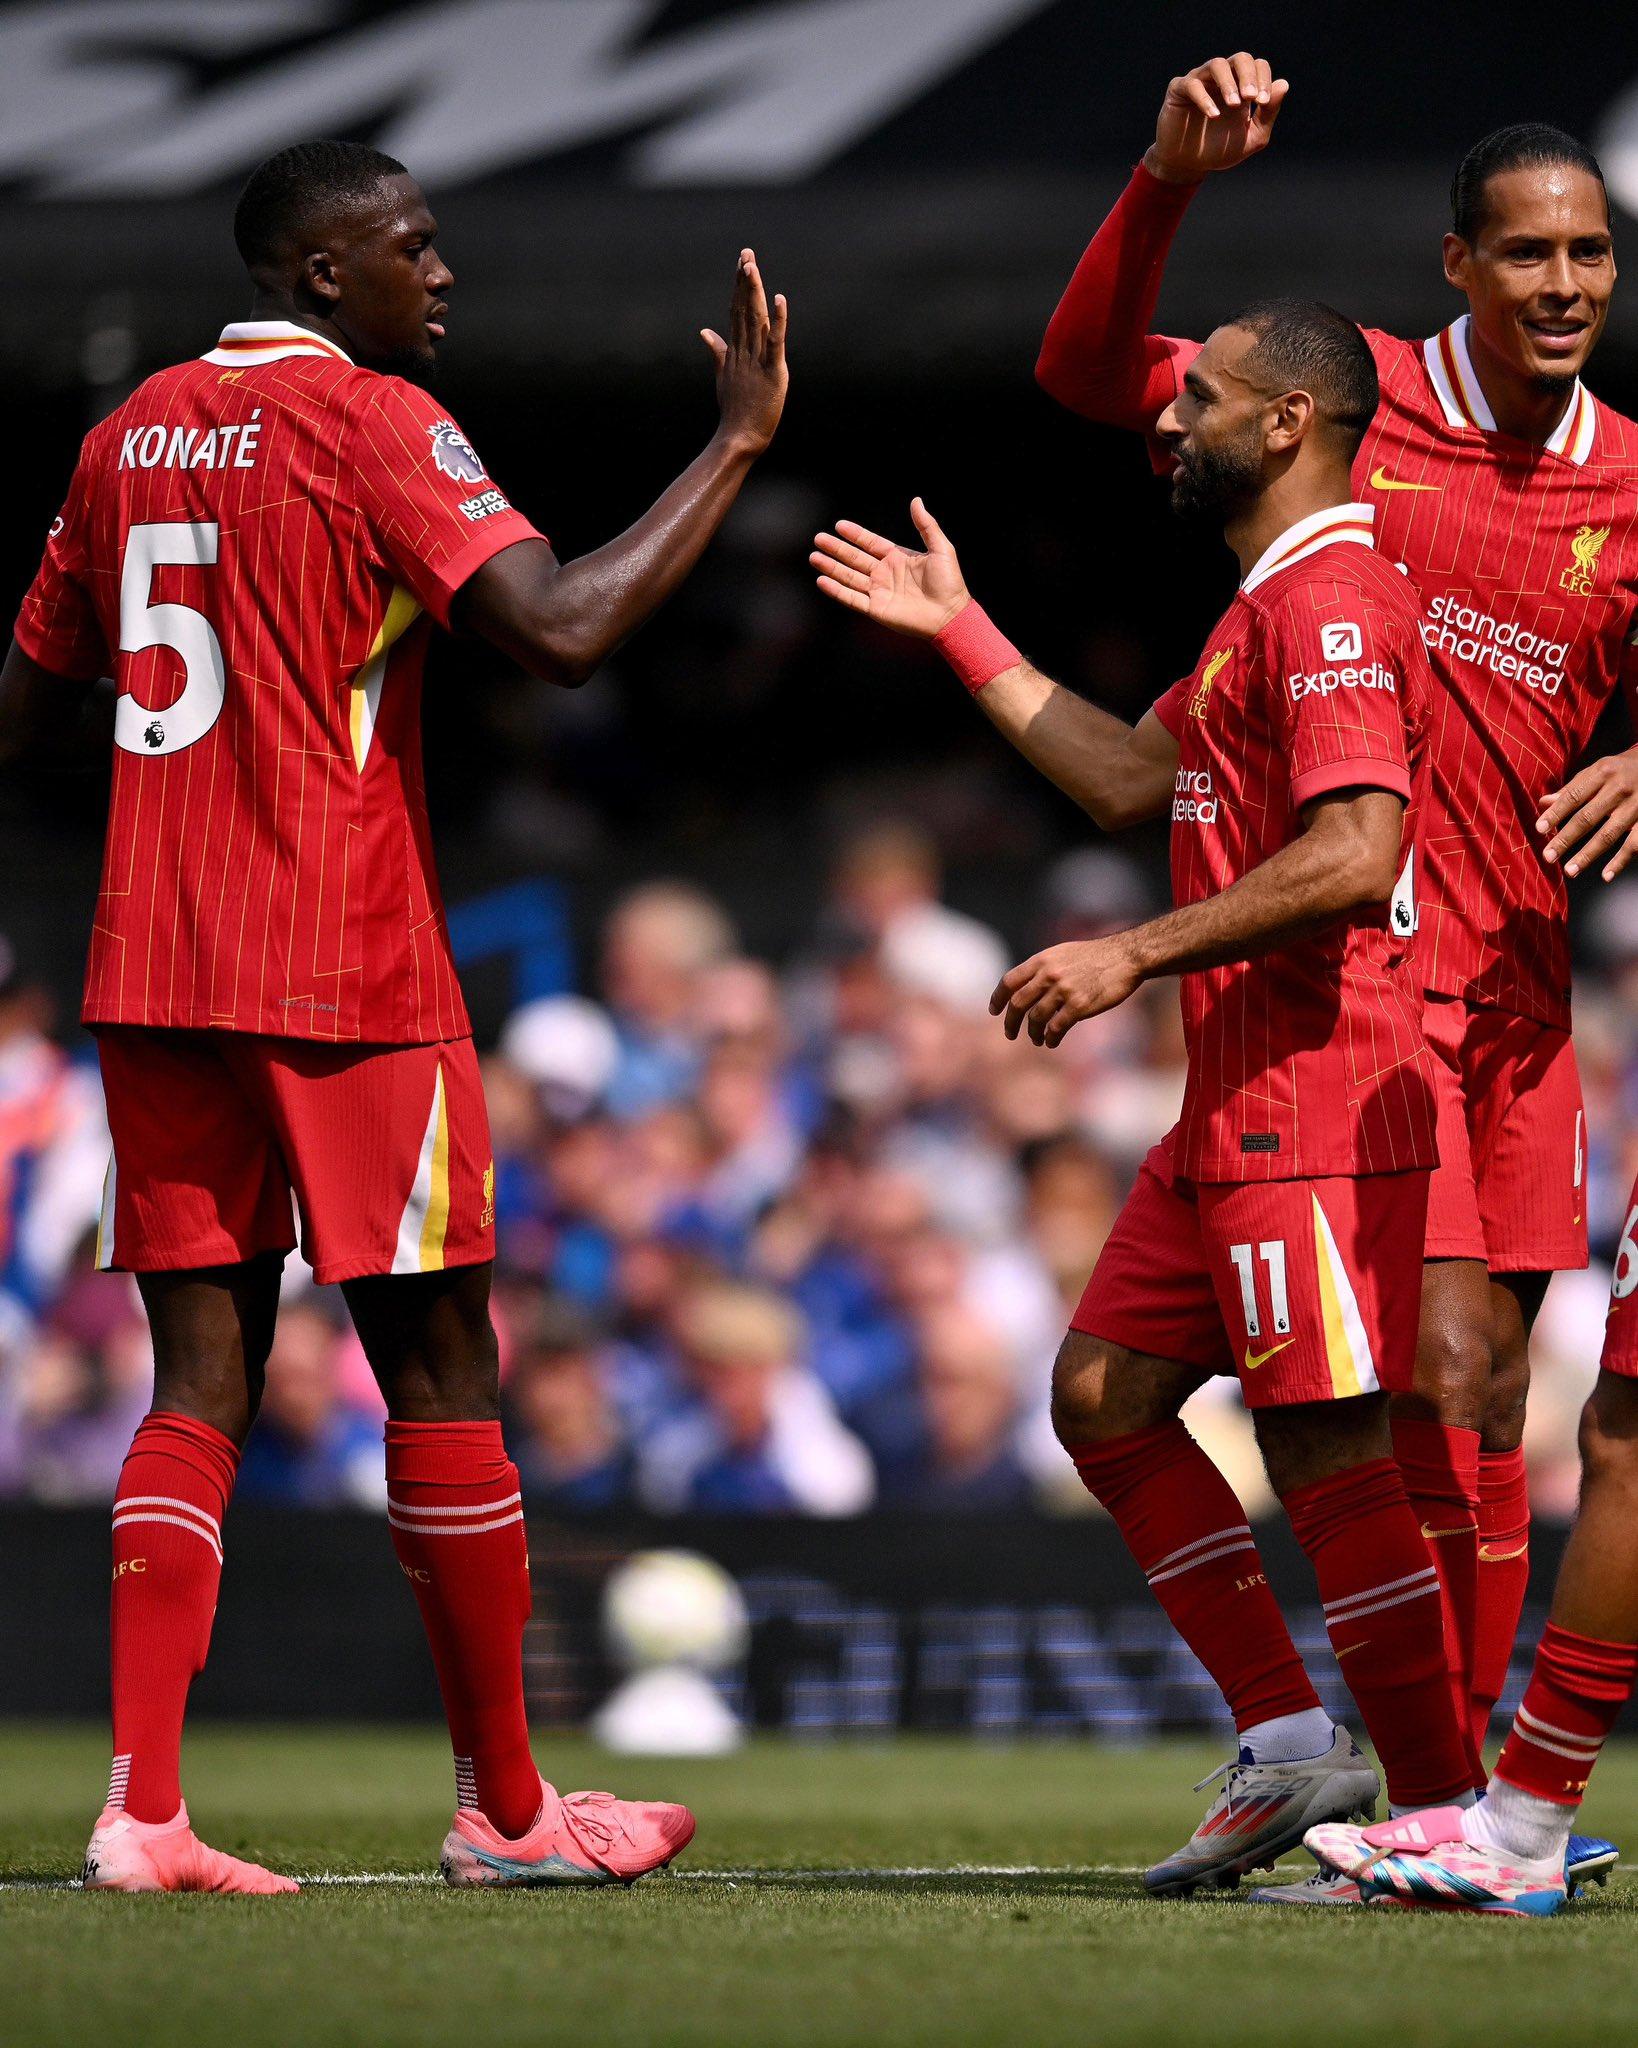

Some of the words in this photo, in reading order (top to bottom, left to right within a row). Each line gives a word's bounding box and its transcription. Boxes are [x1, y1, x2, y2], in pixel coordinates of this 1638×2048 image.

[117, 408, 262, 471] KONATÉ
[114, 522, 225, 756] 5
[1423, 624, 1565, 696] chartered
[1427, 596, 1570, 668] standard
[1289, 662, 1396, 702] Expedia
[1229, 1239, 1291, 1337] 11
[1235, 1573, 1267, 1592] LFC
